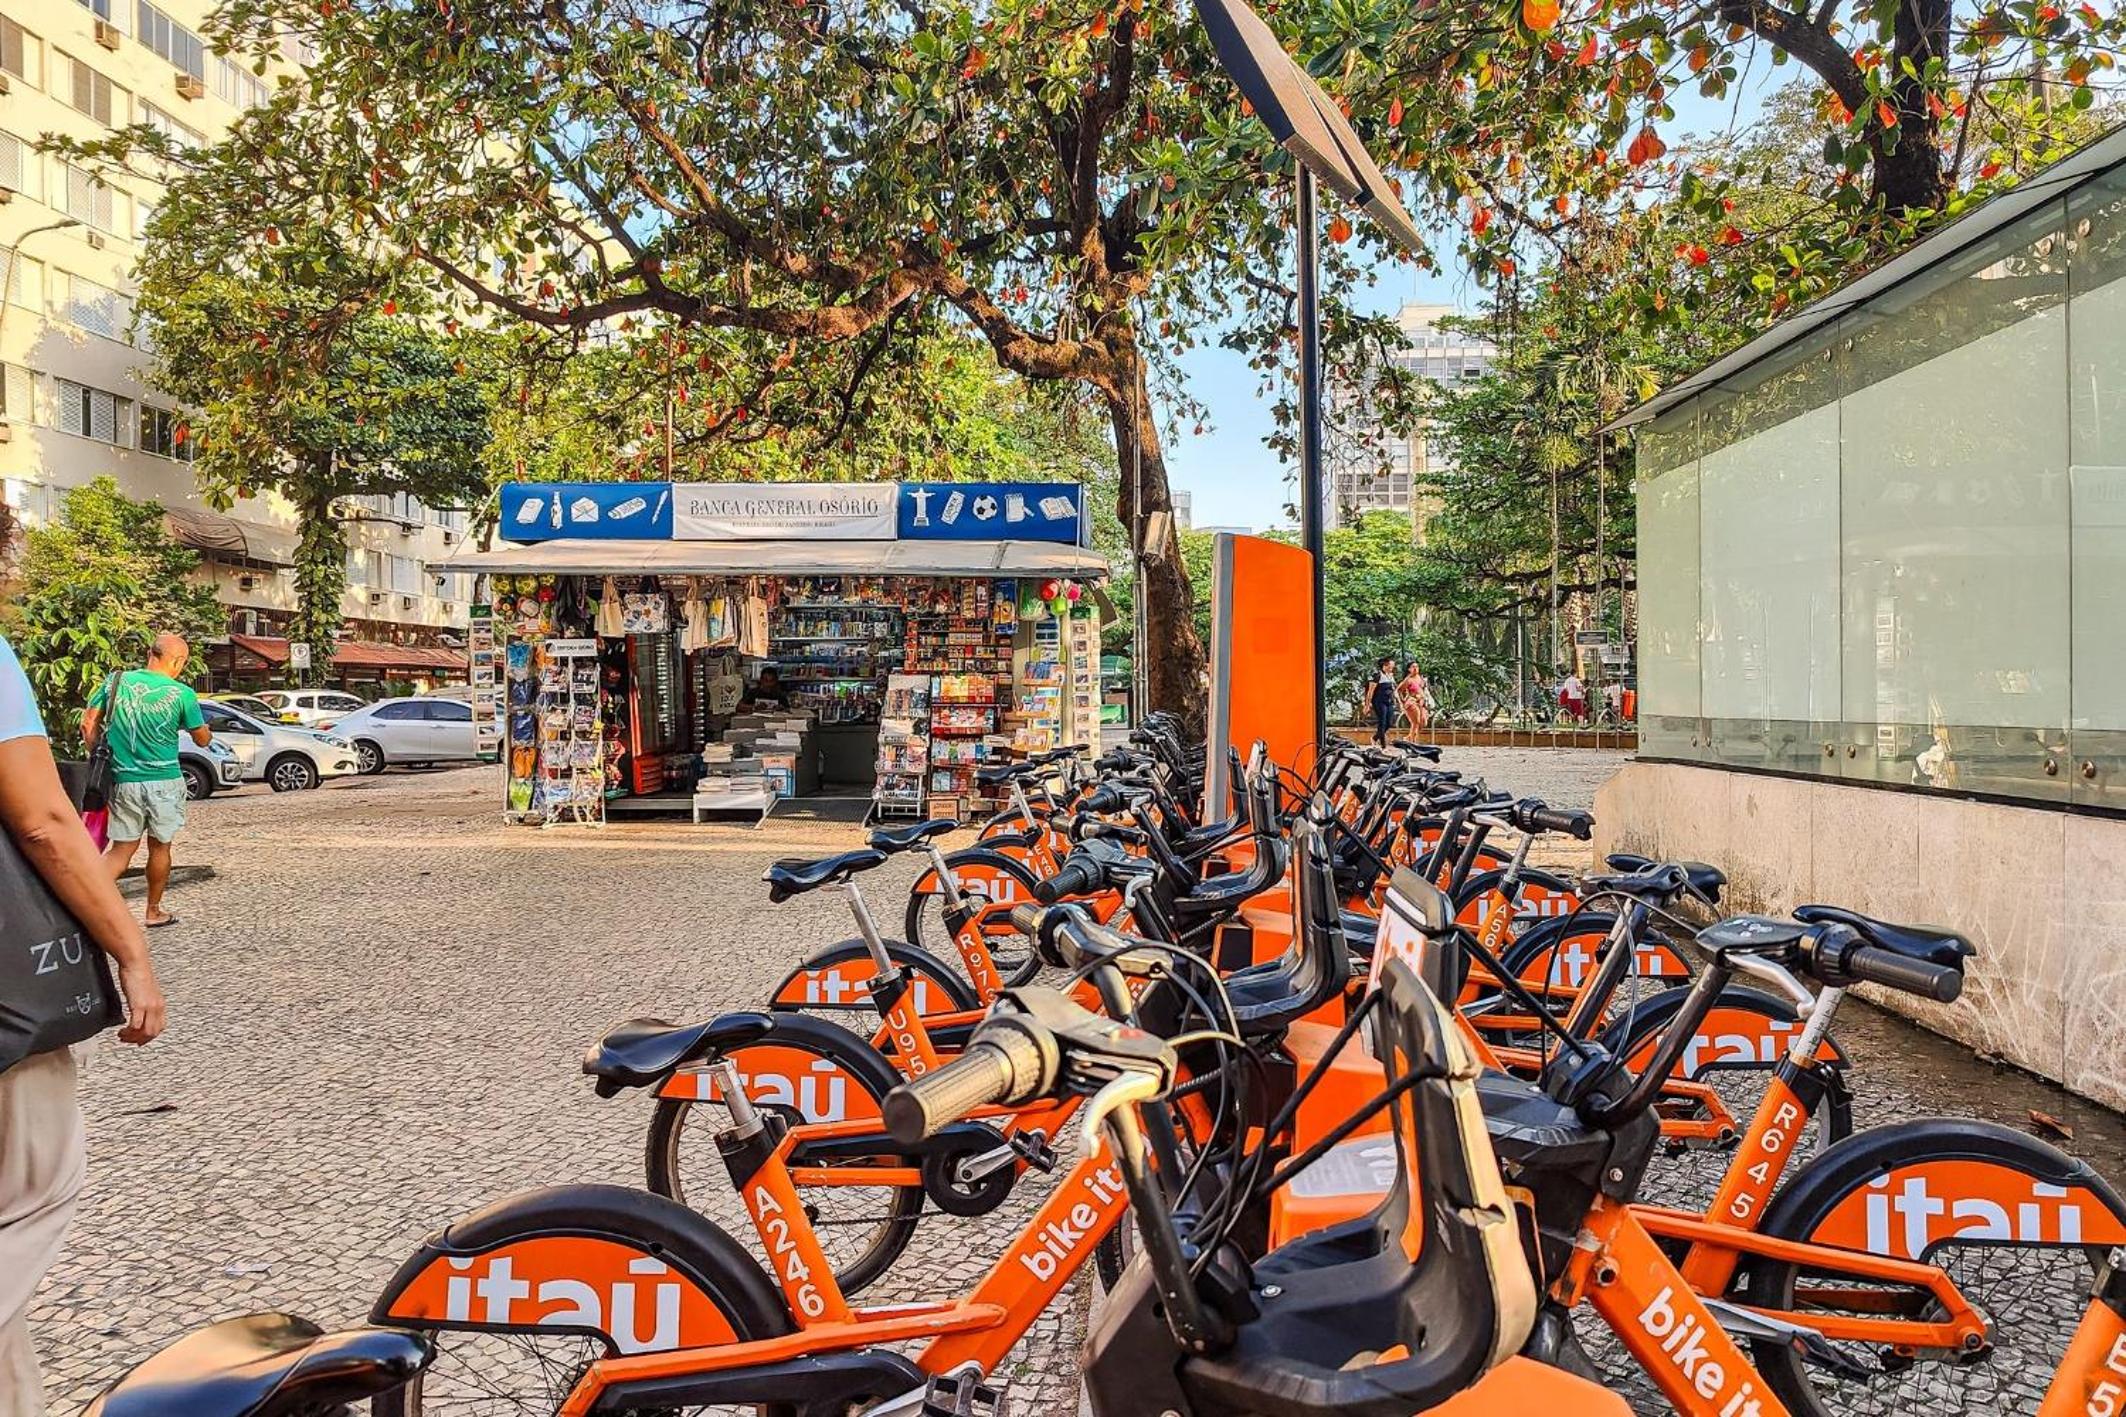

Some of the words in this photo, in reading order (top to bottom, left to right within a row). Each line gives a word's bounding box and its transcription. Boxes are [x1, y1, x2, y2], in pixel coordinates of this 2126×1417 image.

[691, 500, 740, 515] BANCA
[745, 500, 816, 518] GENERAL
[1730, 1101, 1798, 1218] R645
[755, 1185, 825, 1318] A246
[1020, 1202, 1099, 1282] bike
[1866, 1172, 2082, 1261] itaú
[446, 1255, 682, 1355] itaú
[1638, 1286, 1725, 1399] bike
